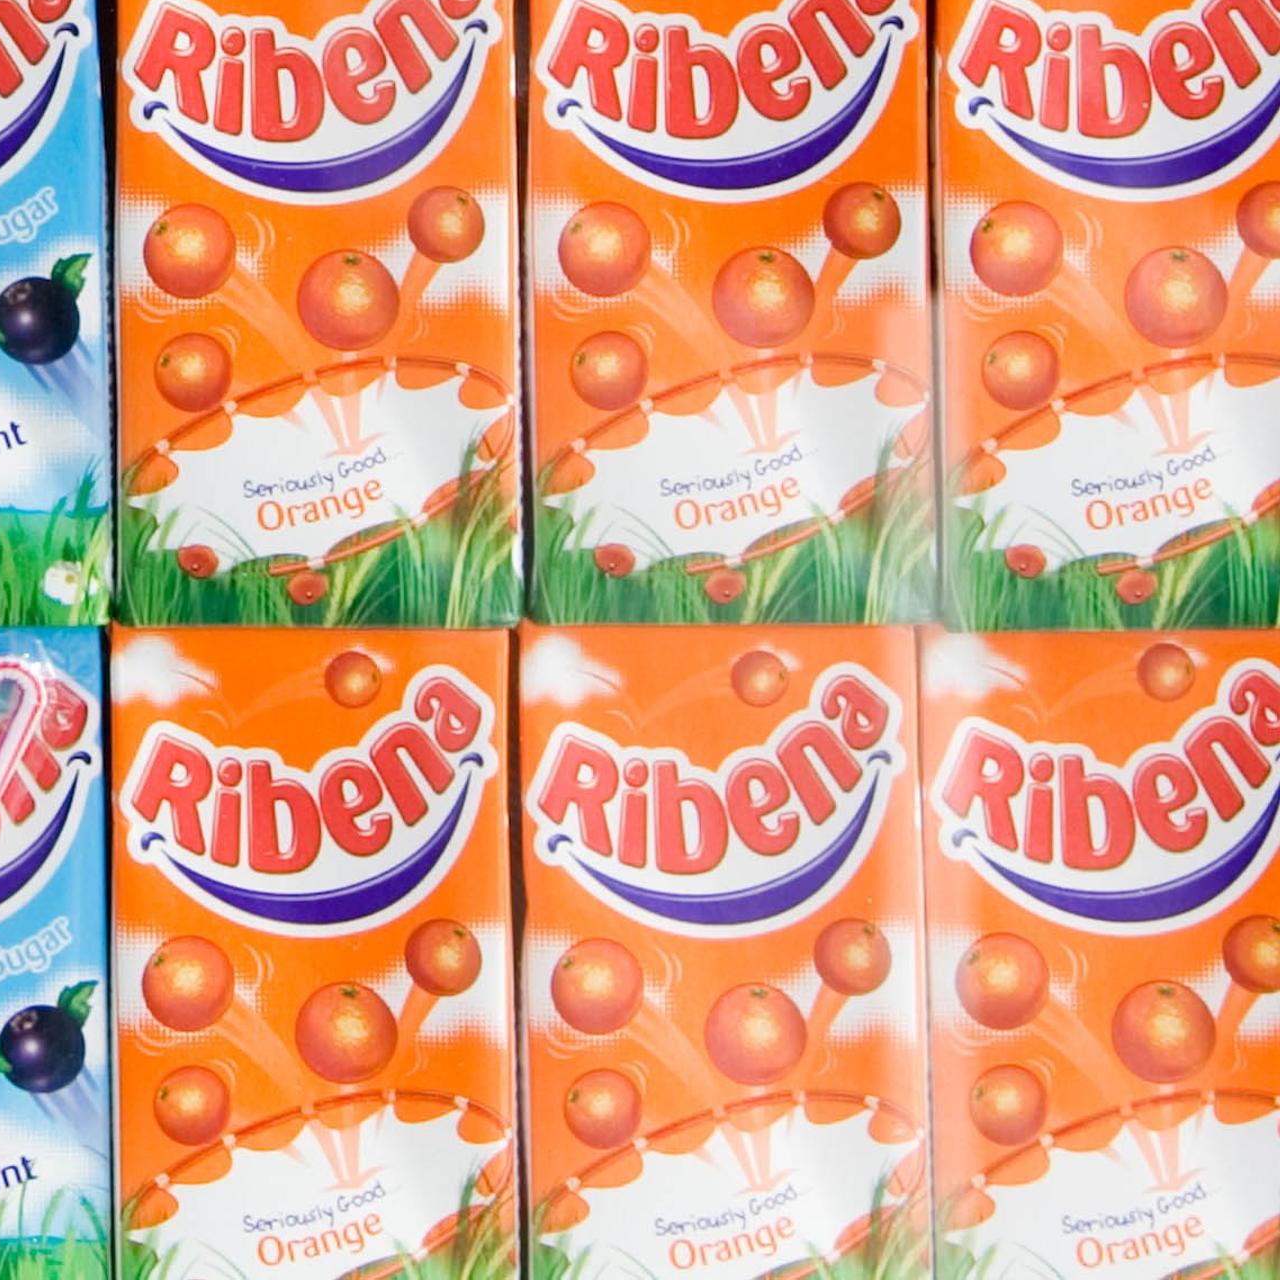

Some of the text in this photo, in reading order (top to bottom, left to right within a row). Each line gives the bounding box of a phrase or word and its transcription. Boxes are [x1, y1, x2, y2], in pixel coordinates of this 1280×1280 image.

[243, 471, 334, 498] Seriously
[257, 479, 382, 531] Orange
[673, 474, 802, 531] Orange
[1071, 469, 1163, 499] Seriously
[1085, 474, 1213, 532] Orange
[131, 676, 482, 875] Ribena
[537, 674, 890, 875] Ribena
[942, 669, 1280, 871] Ribena
[256, 1210, 384, 1267] Orange
[668, 1211, 797, 1273] Orange
[1075, 1211, 1206, 1270] Orange
